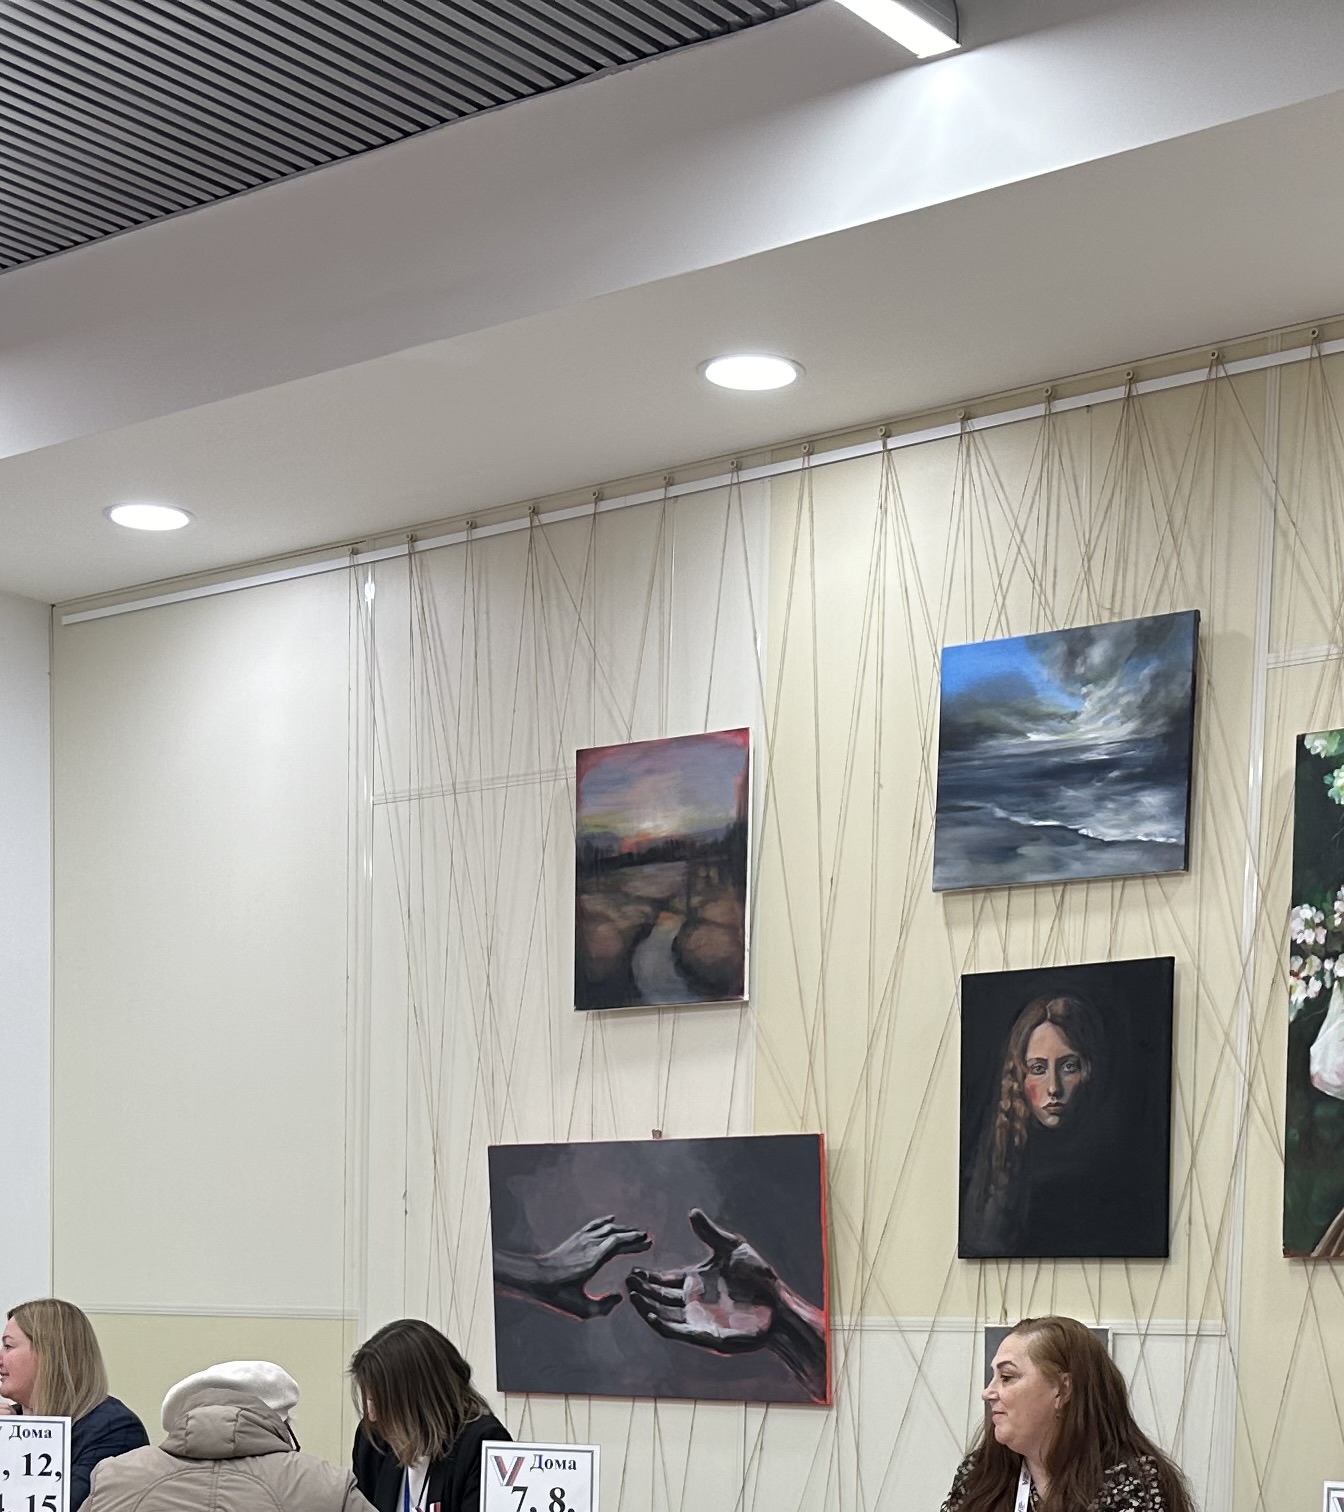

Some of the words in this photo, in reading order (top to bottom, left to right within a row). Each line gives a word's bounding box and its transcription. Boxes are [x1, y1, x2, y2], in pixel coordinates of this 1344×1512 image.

[9, 1425, 53, 1440] Дома
[22, 1453, 62, 1482] 12,
[529, 1453, 577, 1472] Дома
